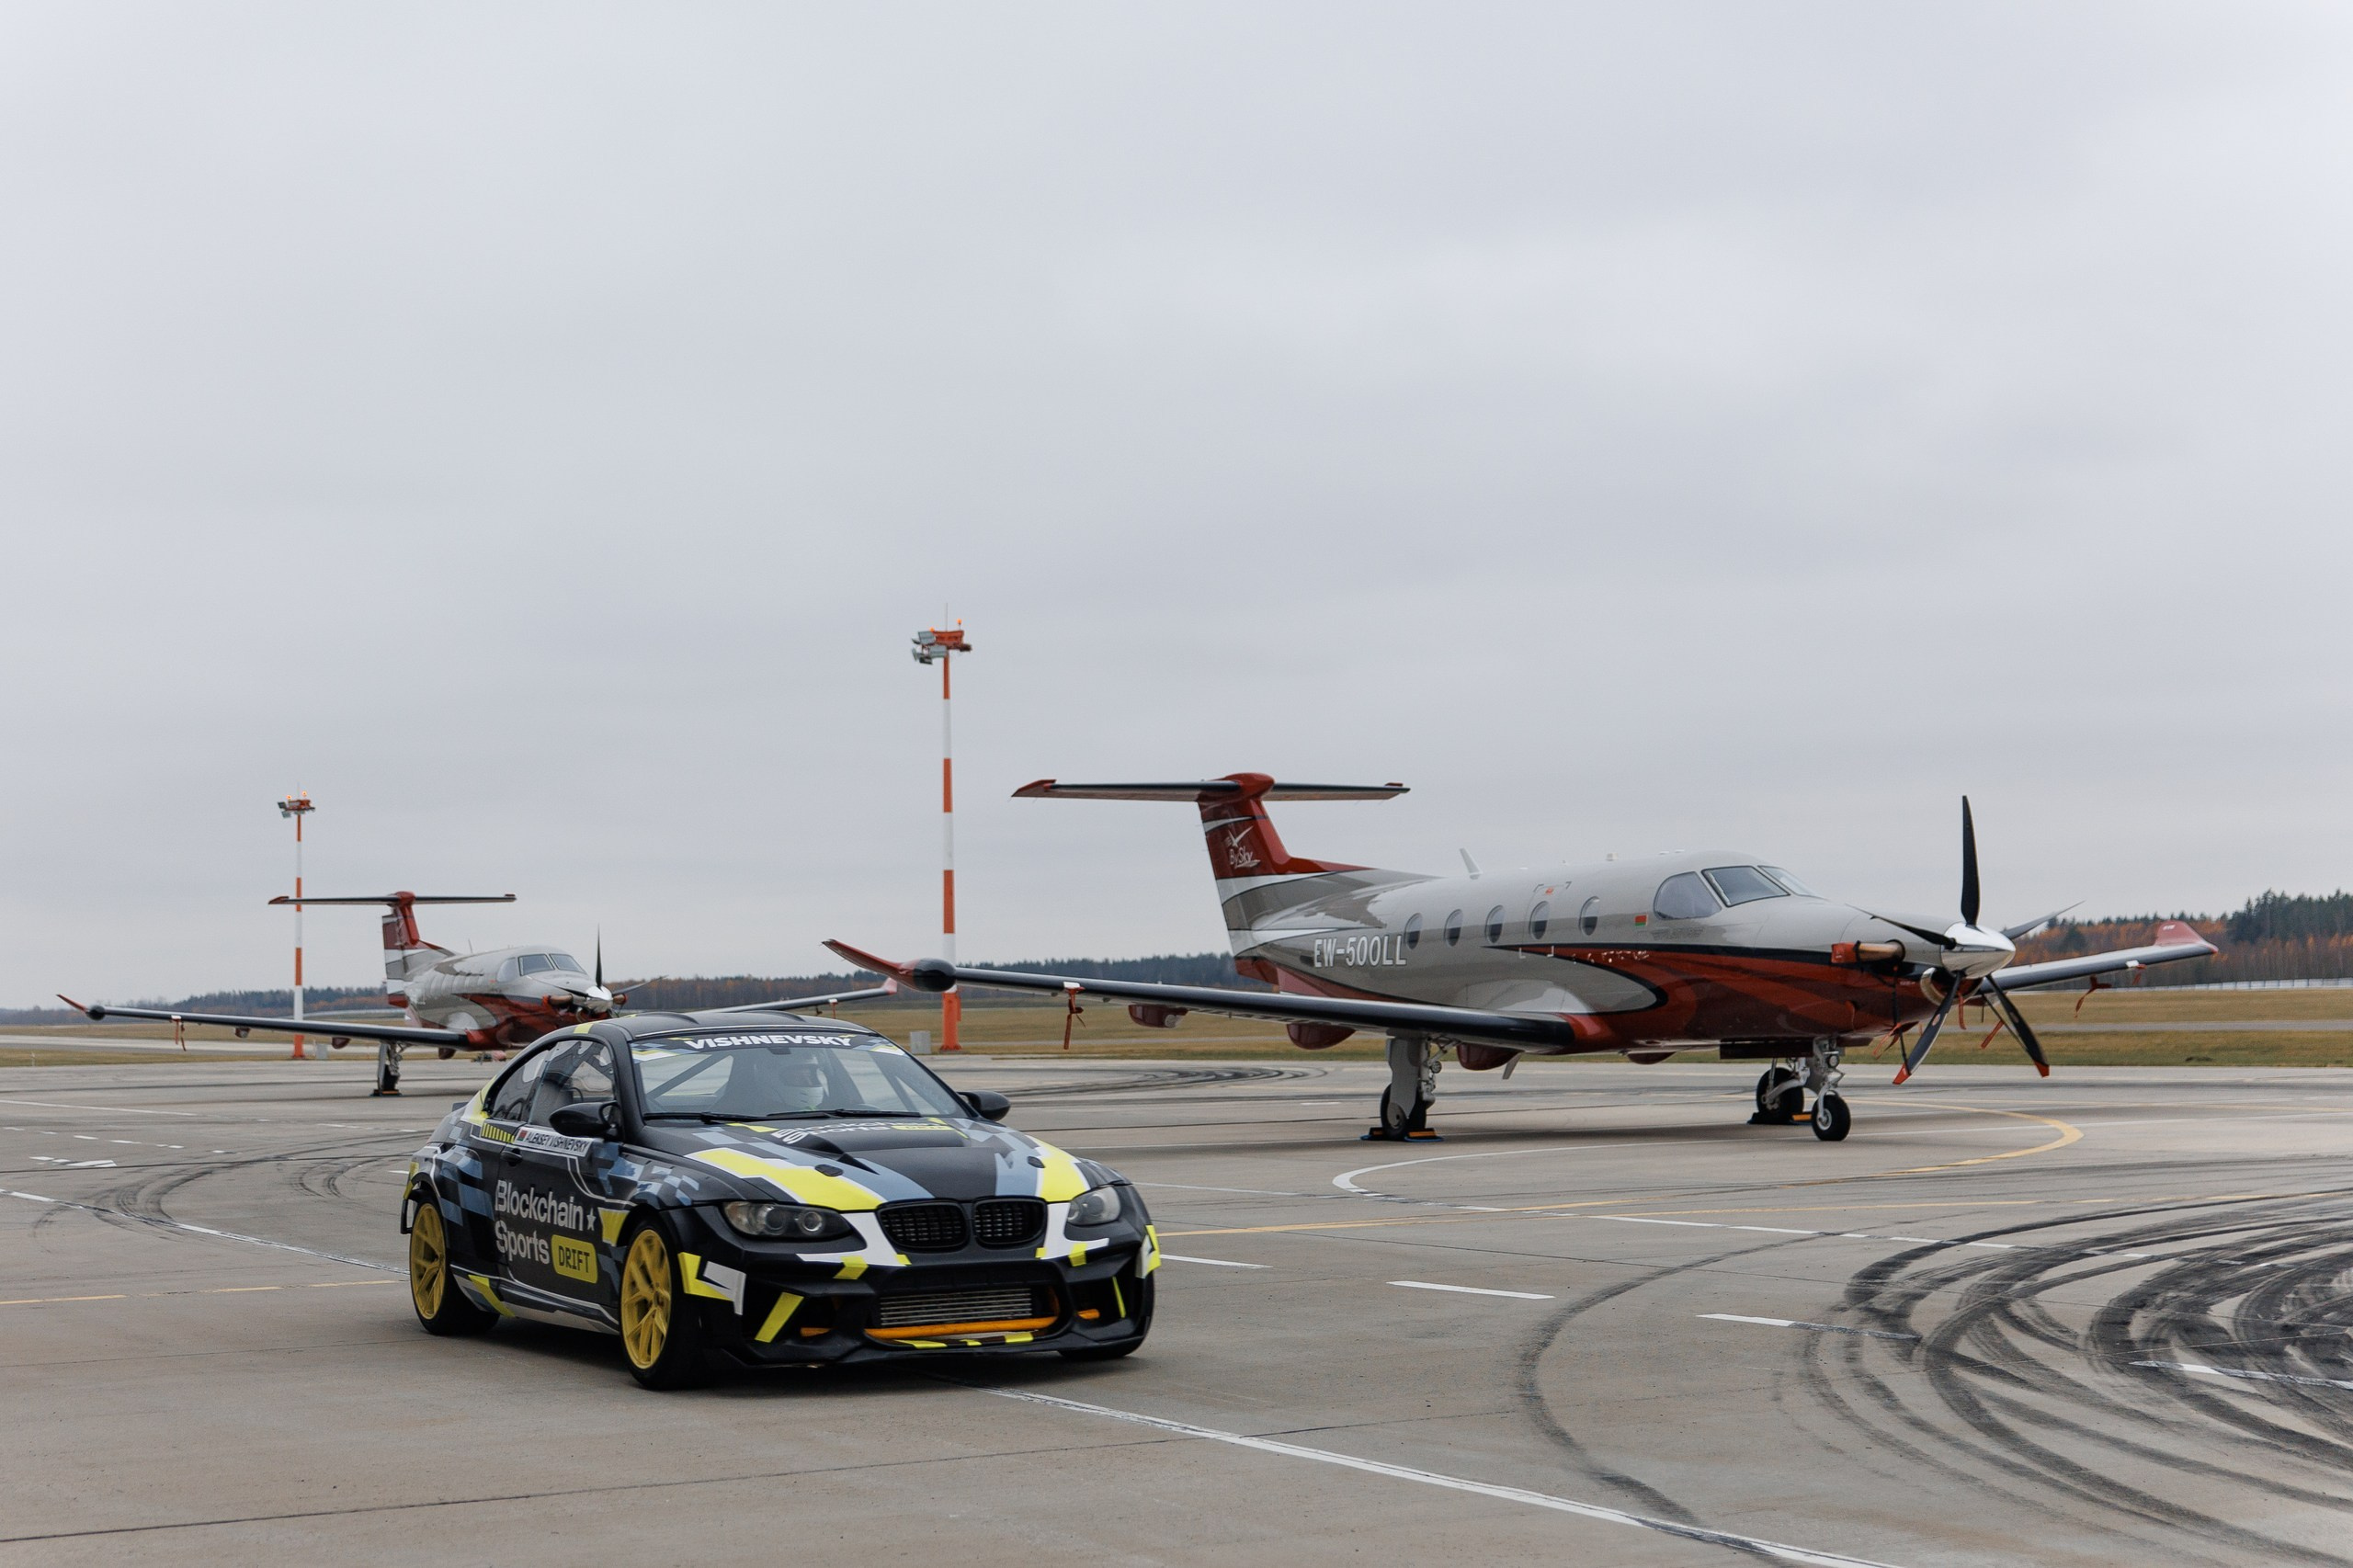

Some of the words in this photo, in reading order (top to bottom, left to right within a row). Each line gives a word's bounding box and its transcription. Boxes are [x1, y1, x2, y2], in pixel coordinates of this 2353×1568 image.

[1314, 936, 1406, 968] EW-500LL
[684, 1035, 851, 1050] VISHNEVSKY
[548, 1134, 589, 1153] VISHNEVSKY
[495, 1180, 583, 1231] Blockchain
[495, 1220, 550, 1265] Sports
[558, 1245, 589, 1273] DRIFT
